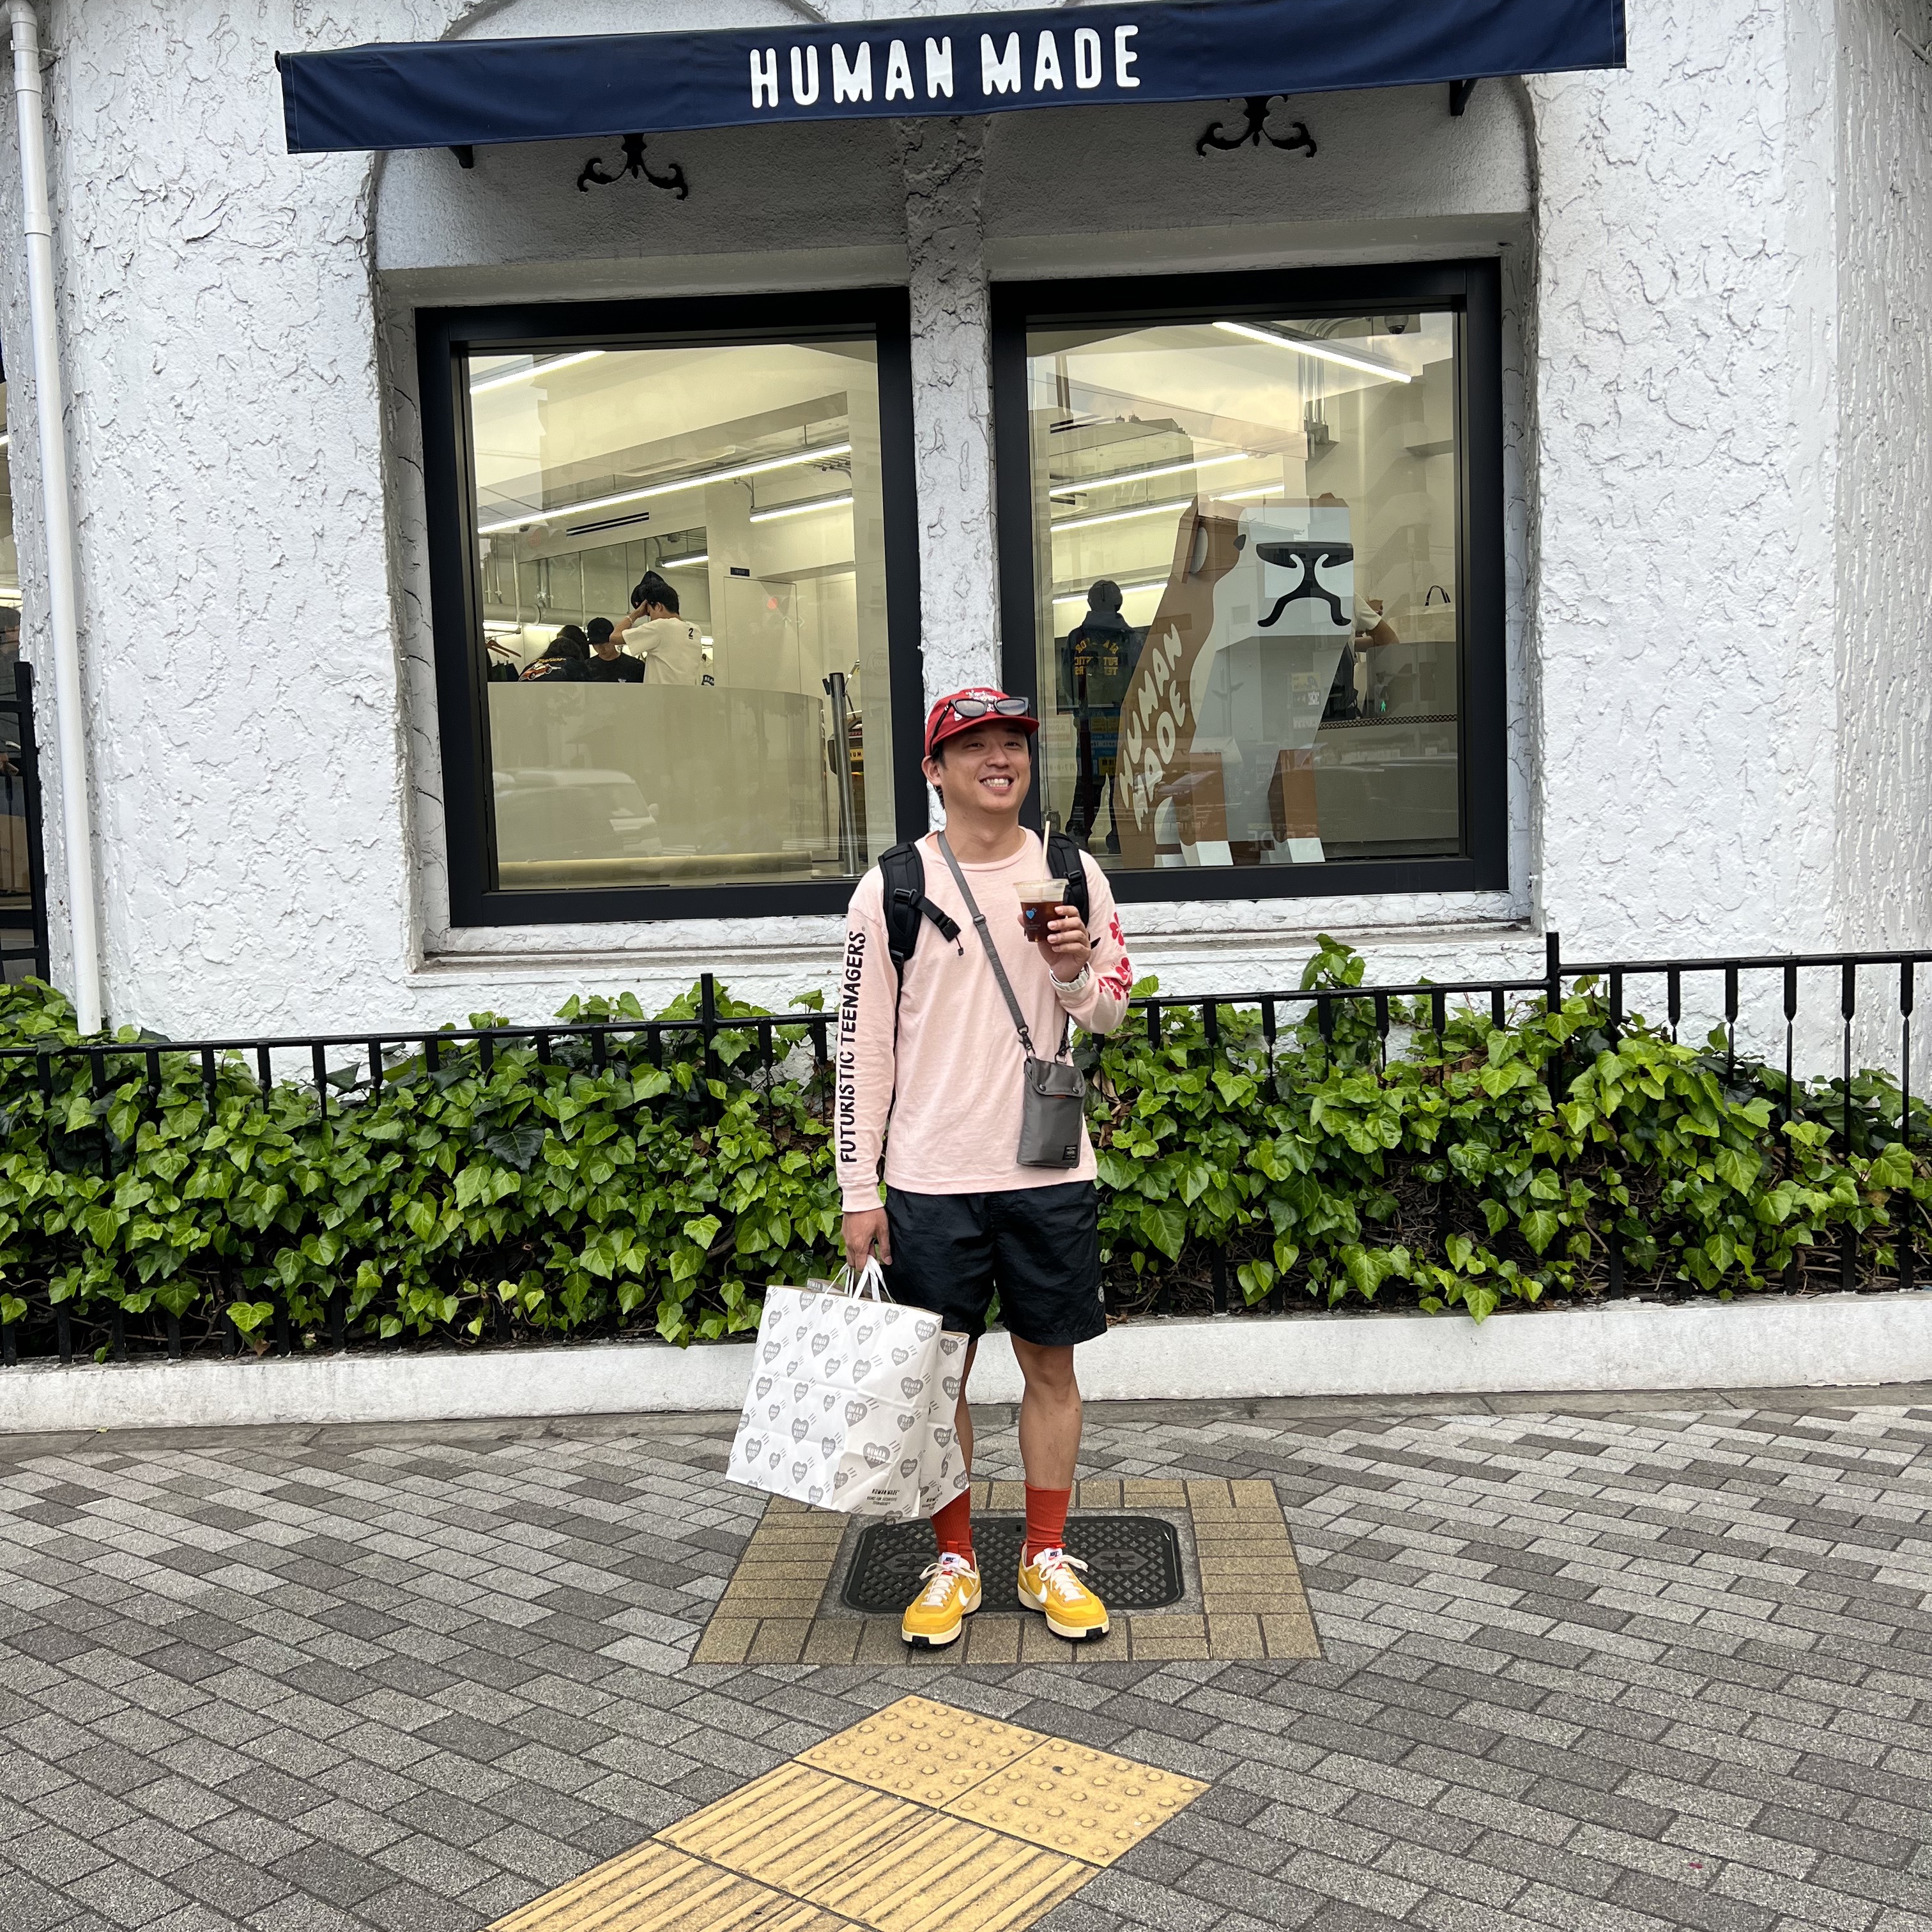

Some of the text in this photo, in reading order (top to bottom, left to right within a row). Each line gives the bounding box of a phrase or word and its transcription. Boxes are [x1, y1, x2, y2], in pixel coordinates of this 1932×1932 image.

[750, 25, 1140, 108] HUMAN MADE
[1119, 624, 1182, 808] HUMAN
[1133, 680, 1186, 831] MADE
[839, 1051, 857, 1162] FUTURISTIC
